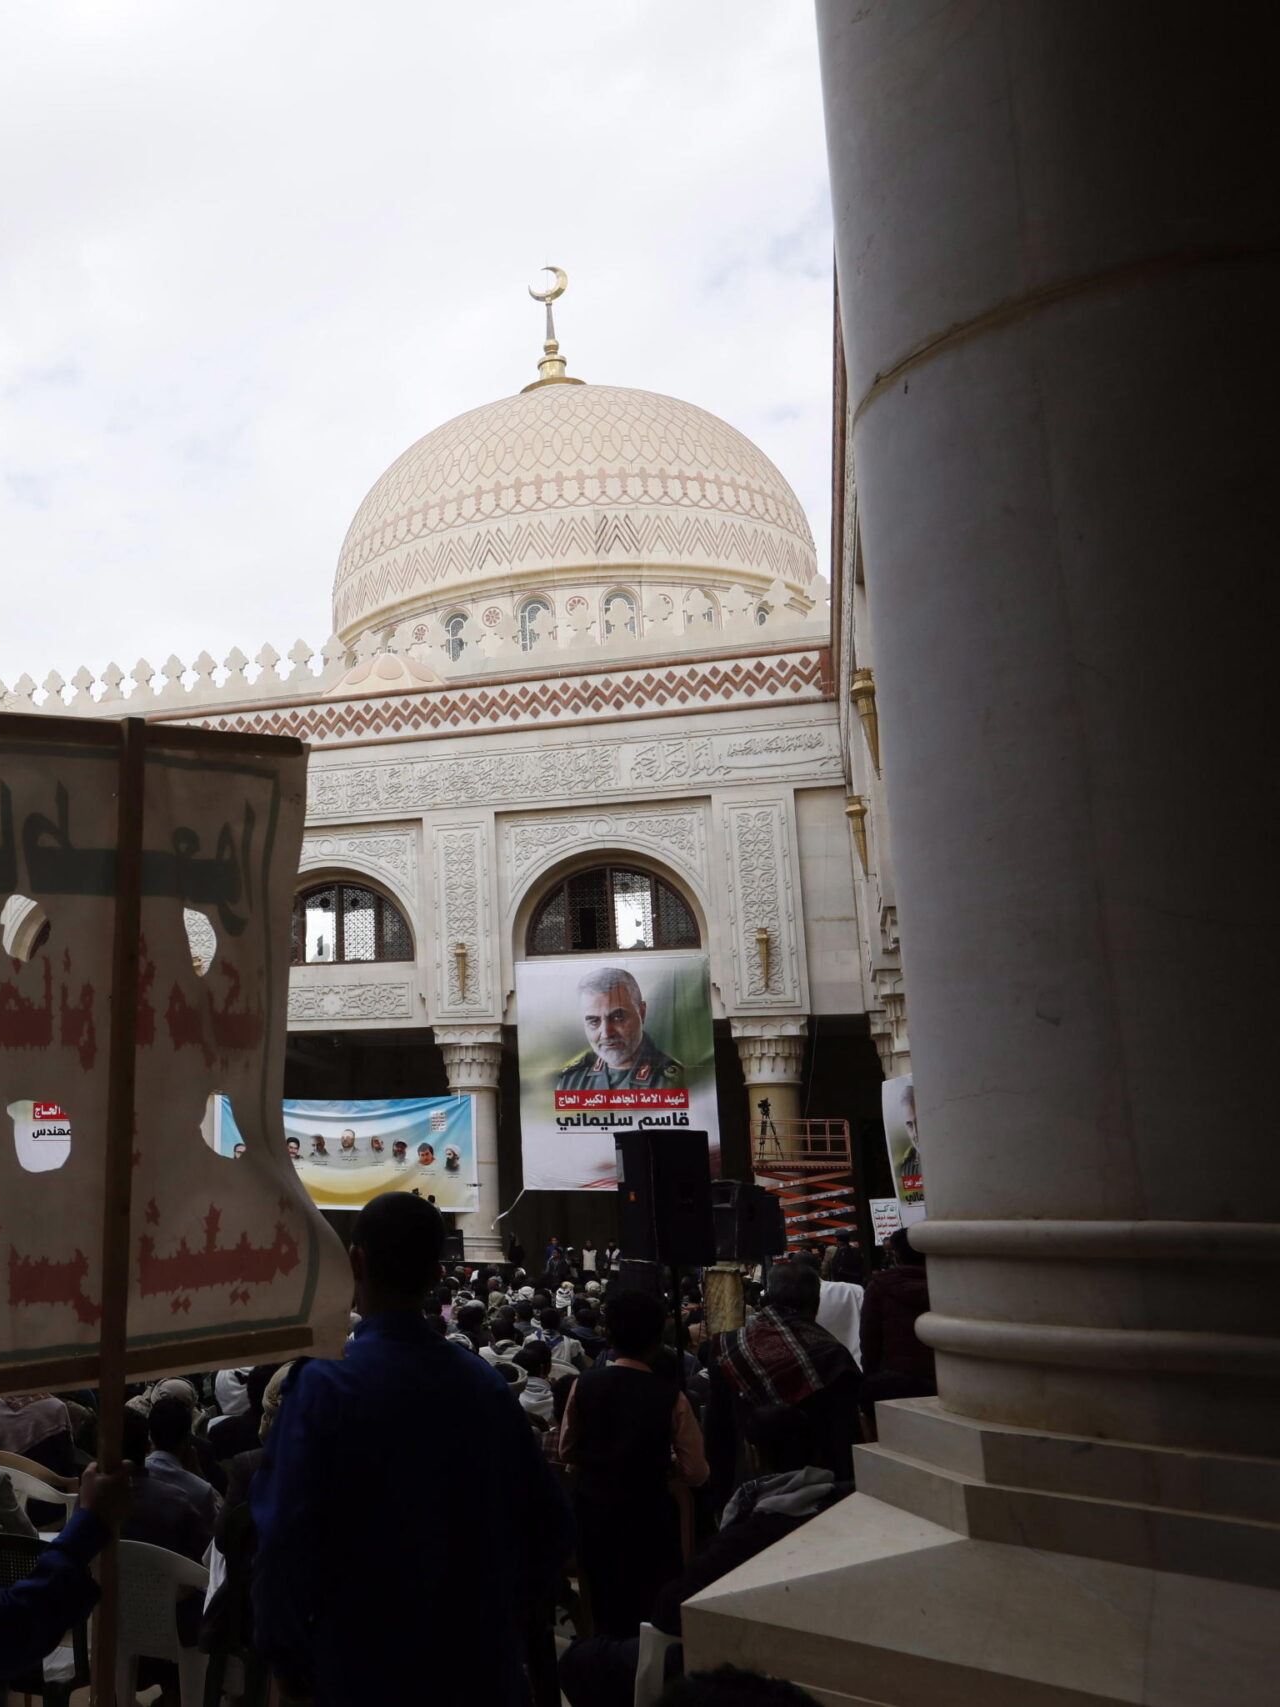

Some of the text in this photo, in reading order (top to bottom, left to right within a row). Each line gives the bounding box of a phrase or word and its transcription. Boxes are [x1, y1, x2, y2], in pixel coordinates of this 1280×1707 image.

[558, 1094, 580, 1107] الحاج
[664, 1092, 686, 1106] شهيد
[34, 1104, 61, 1118] الحاج
[556, 1112, 690, 1131] قاسم سليماني
[32, 1126, 72, 1139] مهندس
